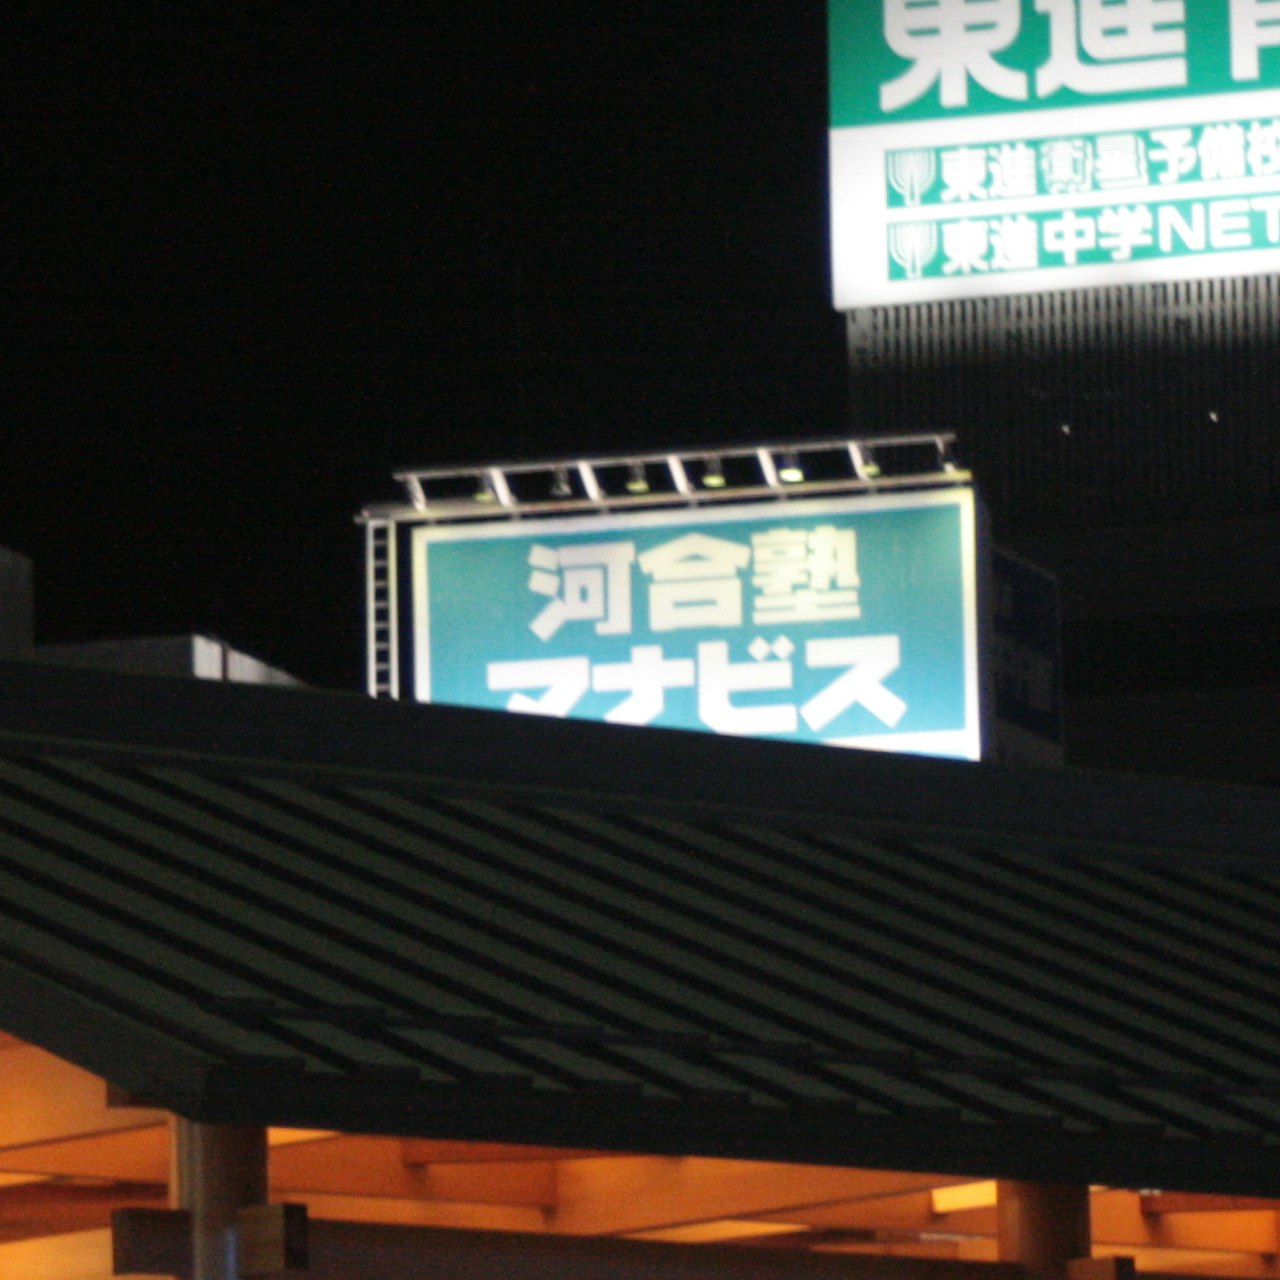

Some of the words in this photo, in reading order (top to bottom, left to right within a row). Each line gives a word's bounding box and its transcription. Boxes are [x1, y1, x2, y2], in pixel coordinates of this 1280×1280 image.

[527, 524, 862, 642] 河合塾
[487, 634, 908, 734] マナビス
